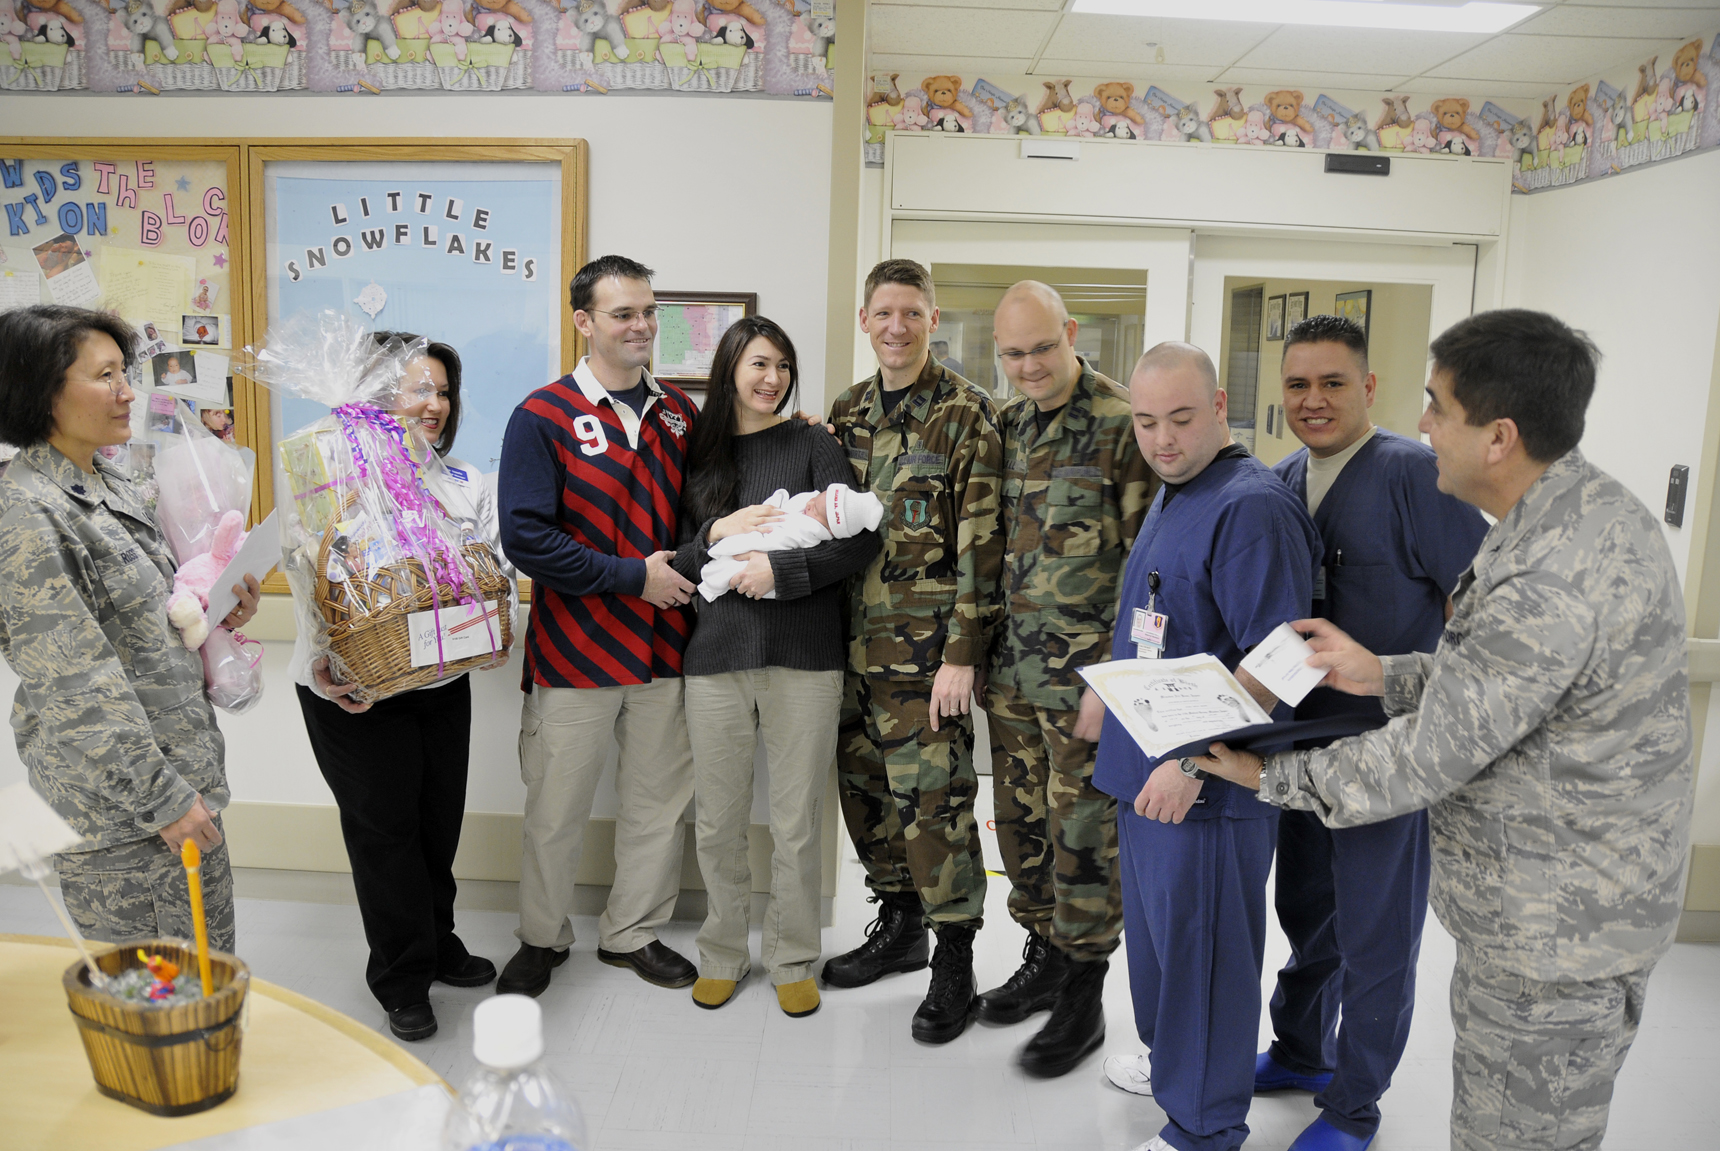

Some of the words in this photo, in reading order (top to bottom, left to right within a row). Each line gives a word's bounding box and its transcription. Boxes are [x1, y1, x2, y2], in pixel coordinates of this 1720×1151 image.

[58, 202, 107, 236] ON
[331, 191, 490, 230] LITTLE
[287, 224, 535, 282] SNOWFLAKES
[573, 414, 609, 457] 9
[918, 454, 943, 464] FORCE
[418, 633, 424, 641] A
[424, 639, 433, 650] for
